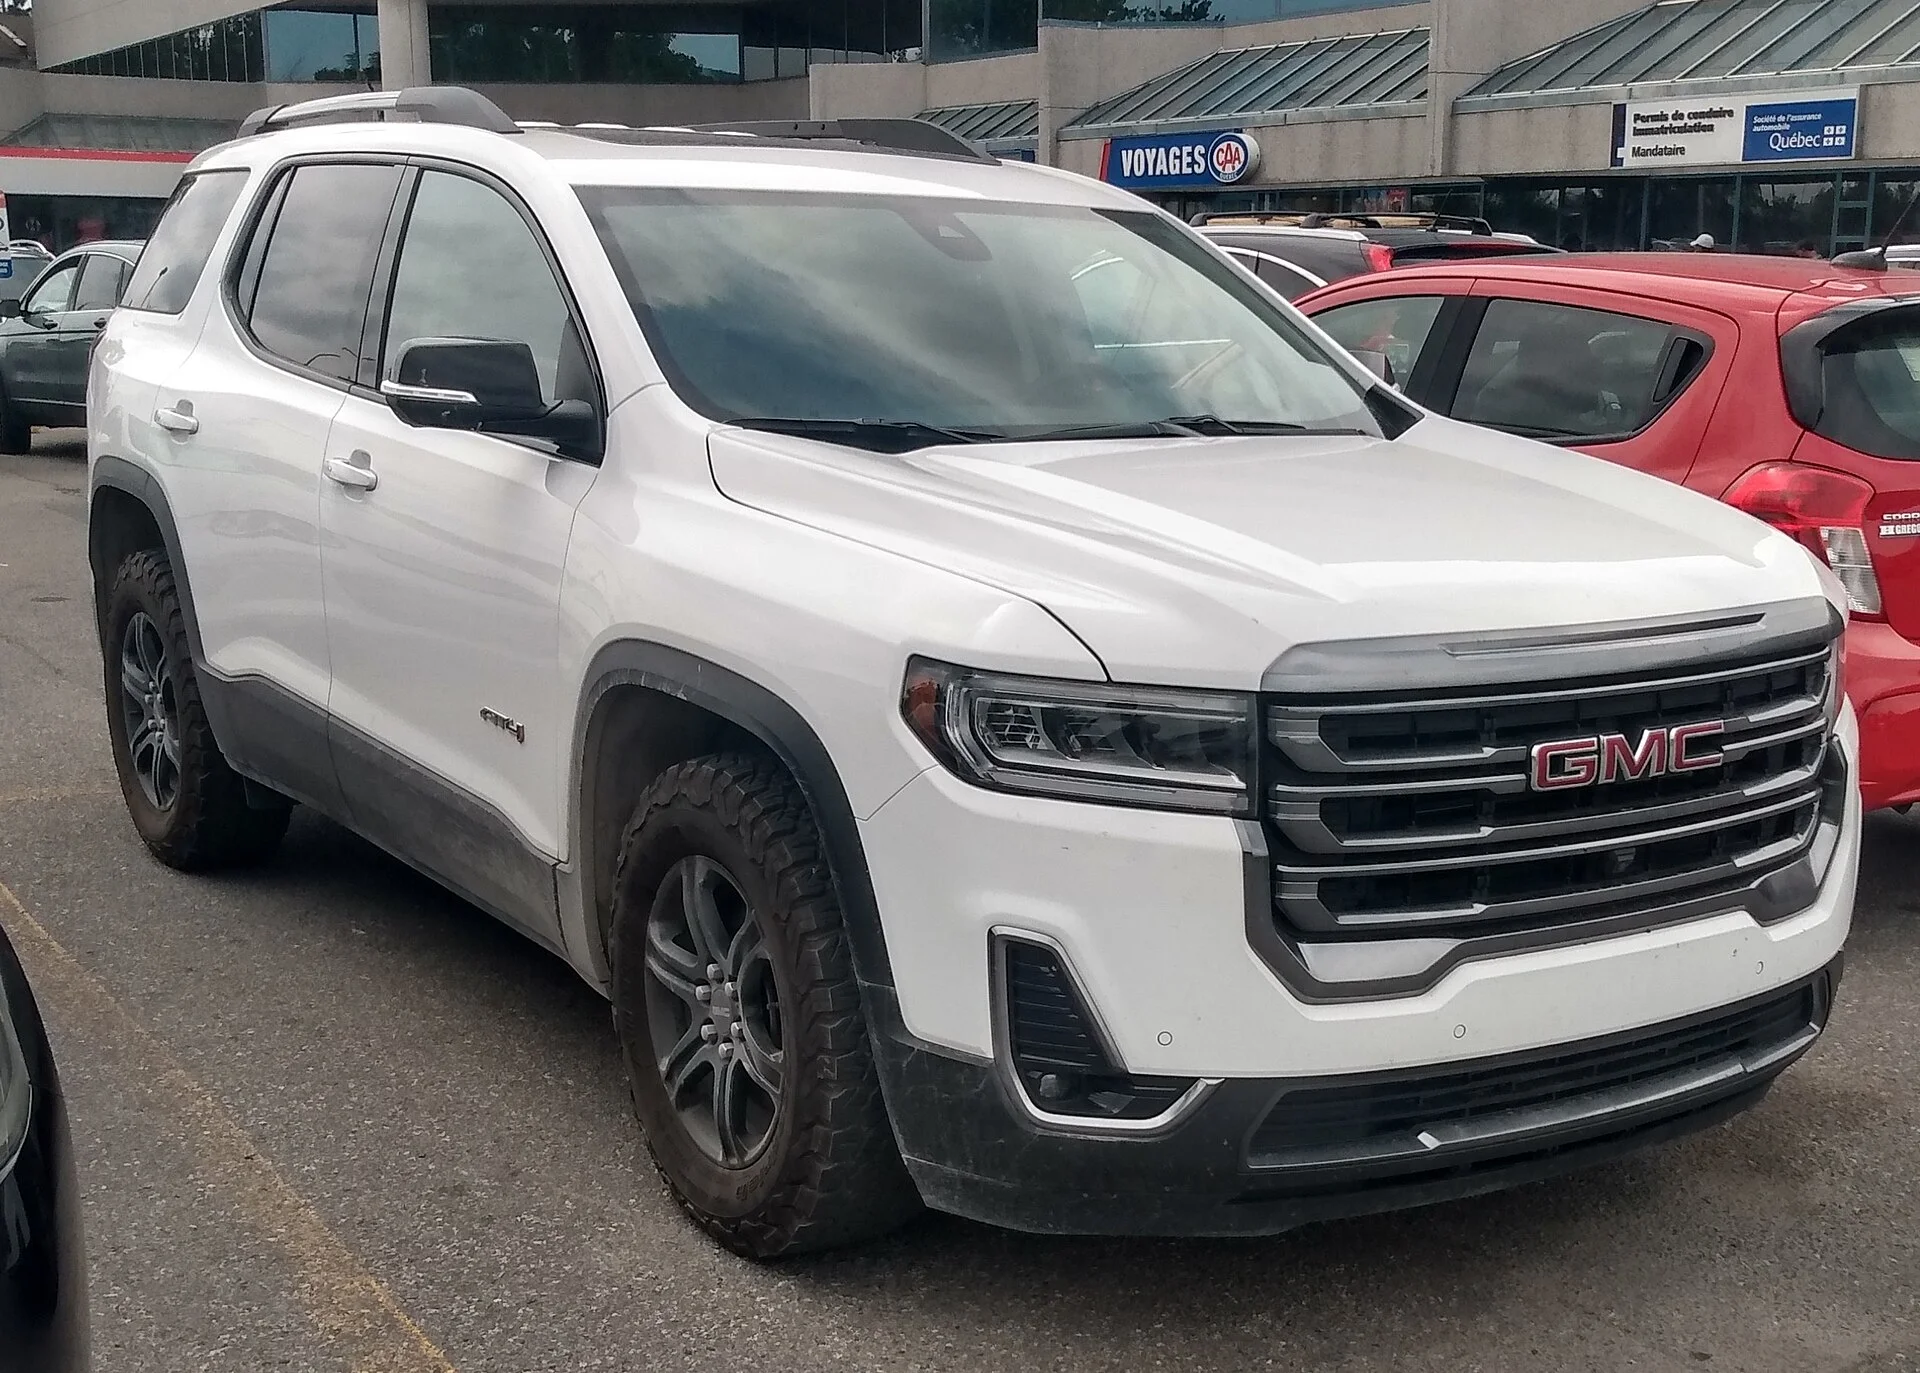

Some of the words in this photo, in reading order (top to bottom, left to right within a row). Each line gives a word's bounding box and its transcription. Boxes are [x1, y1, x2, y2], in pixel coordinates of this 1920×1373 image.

[1633, 111, 1669, 123] Permis
[1671, 110, 1685, 121] de
[1687, 107, 1734, 120] conduire
[1753, 115, 1776, 123] Société
[1777, 114, 1785, 122] de
[1632, 122, 1715, 136] Immatriculation
[1753, 123, 1790, 131] automobile
[1769, 131, 1820, 151] Québec
[1631, 144, 1686, 157] Mandataire
[1121, 145, 1206, 177] VOYAGES
[1216, 143, 1241, 172] CAA
[1531, 720, 1724, 792] GMC
